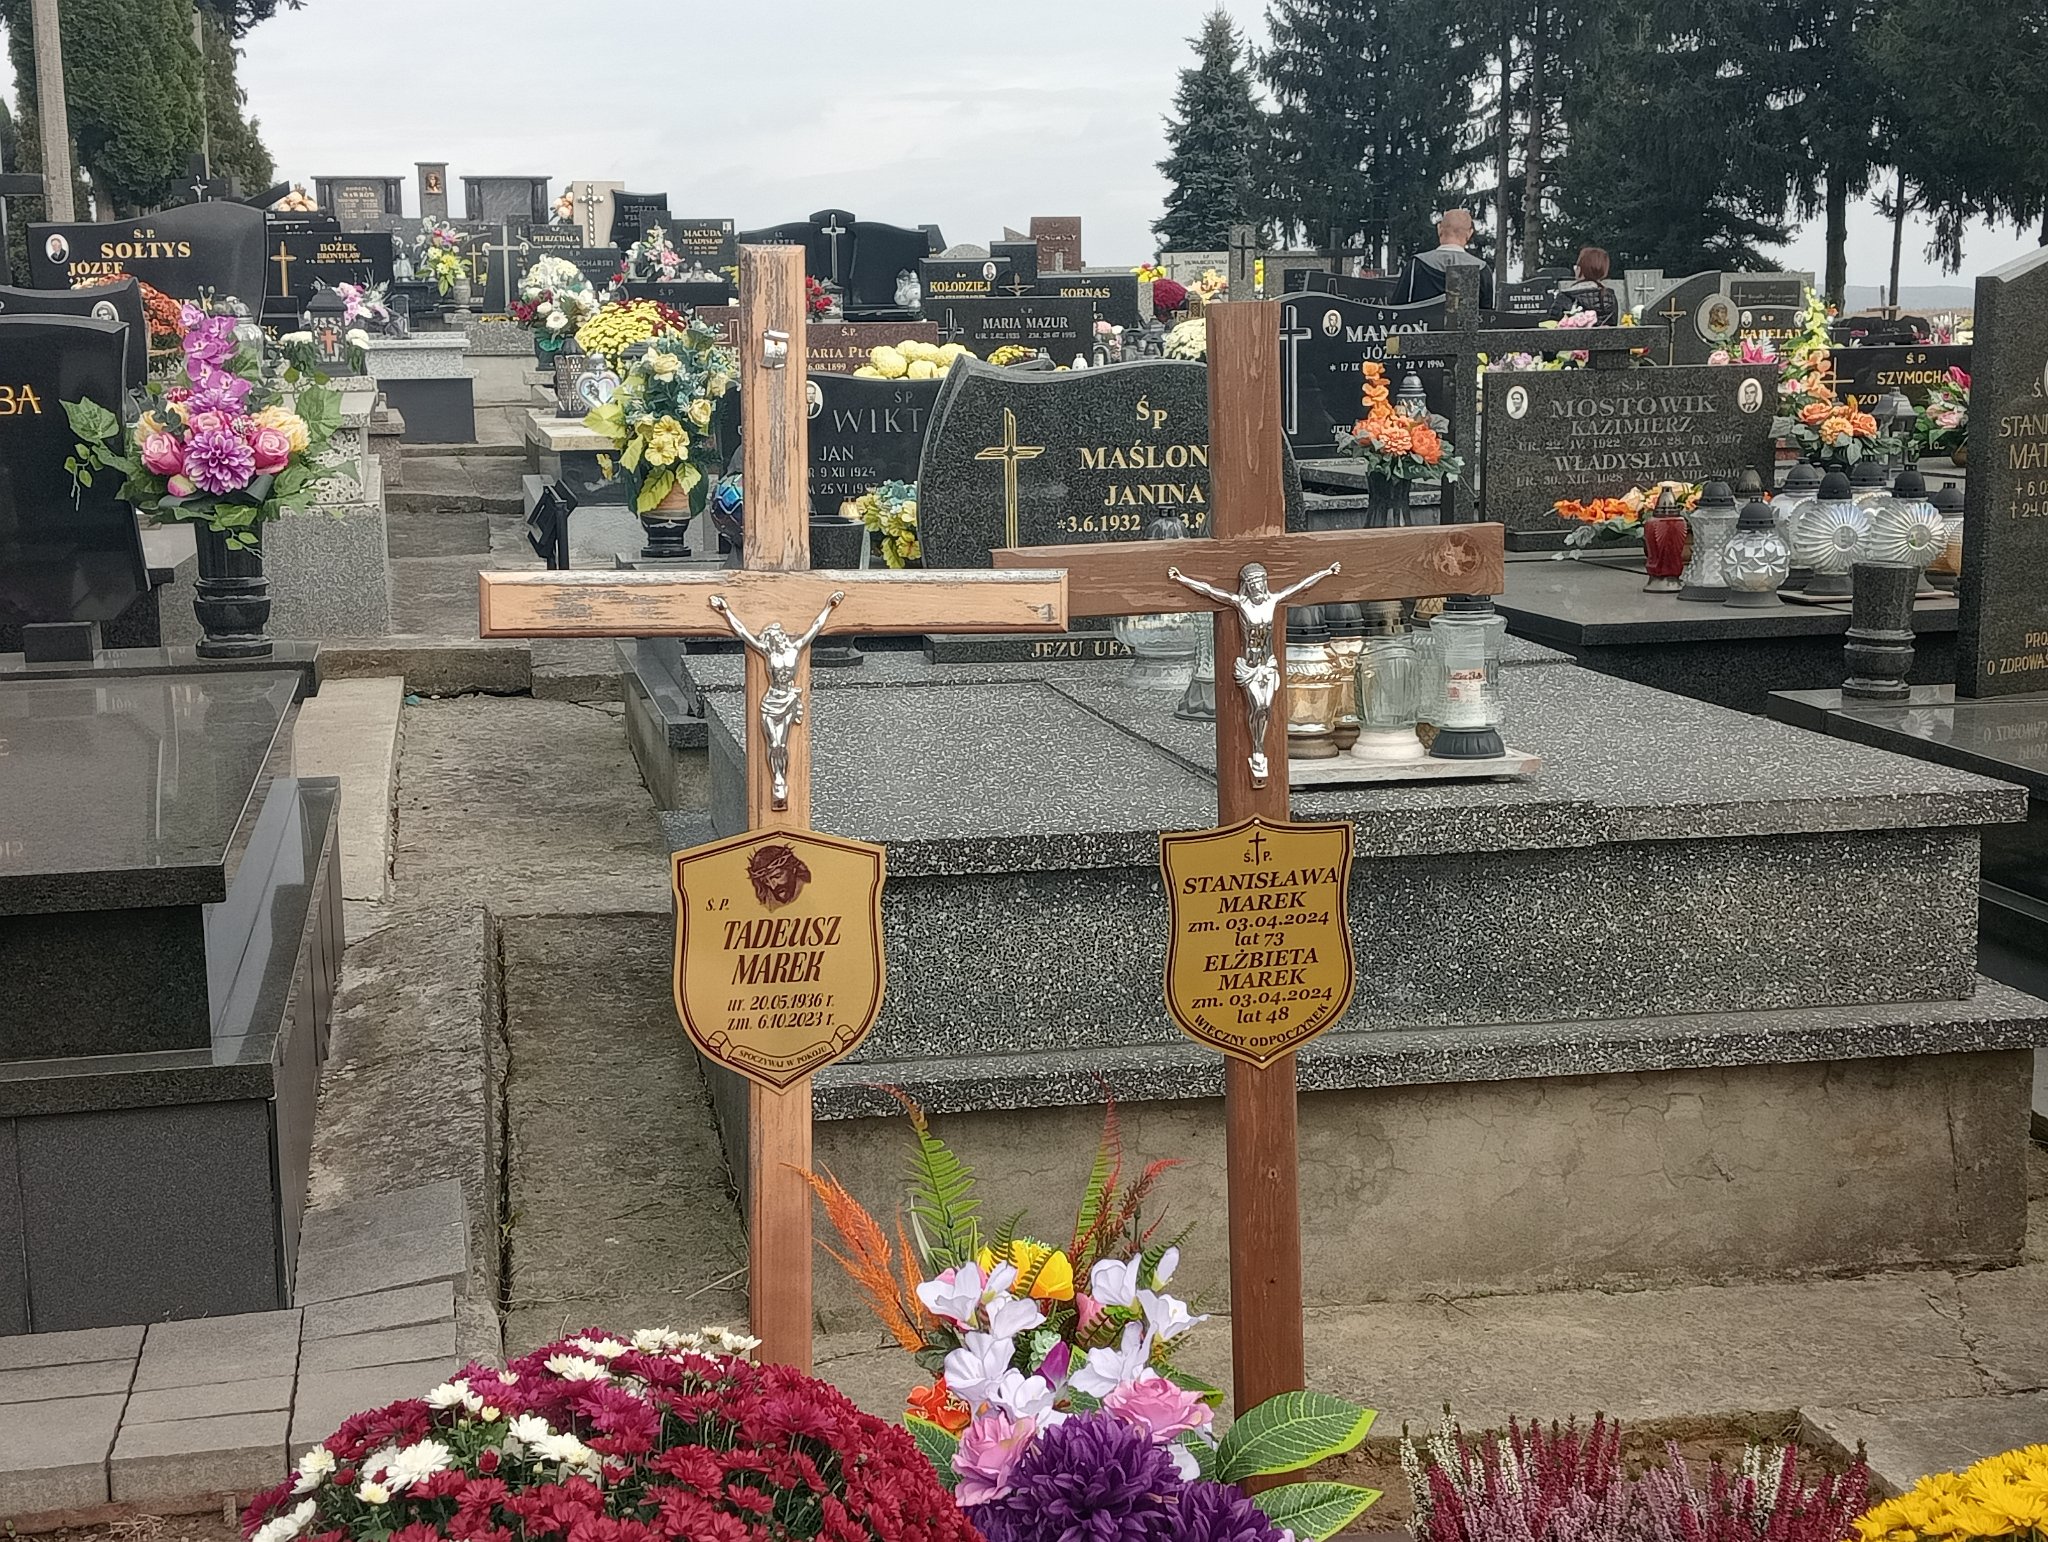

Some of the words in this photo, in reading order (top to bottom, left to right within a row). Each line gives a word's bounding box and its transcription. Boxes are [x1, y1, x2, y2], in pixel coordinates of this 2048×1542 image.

[100, 241, 191, 259] SOŁTYS
[320, 242, 358, 252] BOŻEK
[67, 259, 124, 276] JÓZEF
[930, 280, 992, 292] KOŁODZIEJ
[1060, 284, 1111, 298] KORNAŚ
[982, 317, 1022, 330] MARIA
[1026, 316, 1068, 329] MAZUR
[1551, 394, 1717, 418] MOSTOWIK
[1570, 416, 1695, 436] KAZIMIERZ
[818, 445, 854, 462] JAN
[1554, 451, 1702, 472] WŁADYSŁAWA
[850, 466, 876, 478] 1924
[1104, 482, 1206, 506] JANINA
[1030, 641, 1084, 658] JEZU
[2025, 632, 2048, 648] PRO
[1987, 660, 1996, 676] O
[1182, 866, 1338, 895] STANISŁAWA
[1216, 891, 1308, 914] MAREK
[1187, 920, 1220, 933] zm.
[1225, 911, 1330, 932] 03.04.2024
[723, 916, 842, 950] TADEUSZ
[1234, 931, 1260, 948] lat
[1264, 932, 1285, 947] 73
[731, 950, 826, 986] MAREK
[1202, 947, 1320, 973] ELŻBIETA
[1216, 968, 1308, 991] MAREK
[727, 998, 746, 1012] ur.
[750, 993, 824, 1011] 20.05.1936
[826, 994, 835, 1007] r.
[1190, 996, 1224, 1010] zm.
[1229, 987, 1332, 1008] 03.04.2024
[727, 1016, 752, 1031] zm.
[758, 1012, 823, 1030] 6.10.2023
[826, 1012, 835, 1026] r.
[1194, 1014, 1248, 1046] WIECZNY
[1249, 1003, 1328, 1046] ODPOCZYNEK
[1237, 1008, 1263, 1024] lat
[1266, 1006, 1290, 1024] 48
[738, 1050, 784, 1068] SPOCZYWAJ
[796, 1046, 828, 1064] POKOJU
